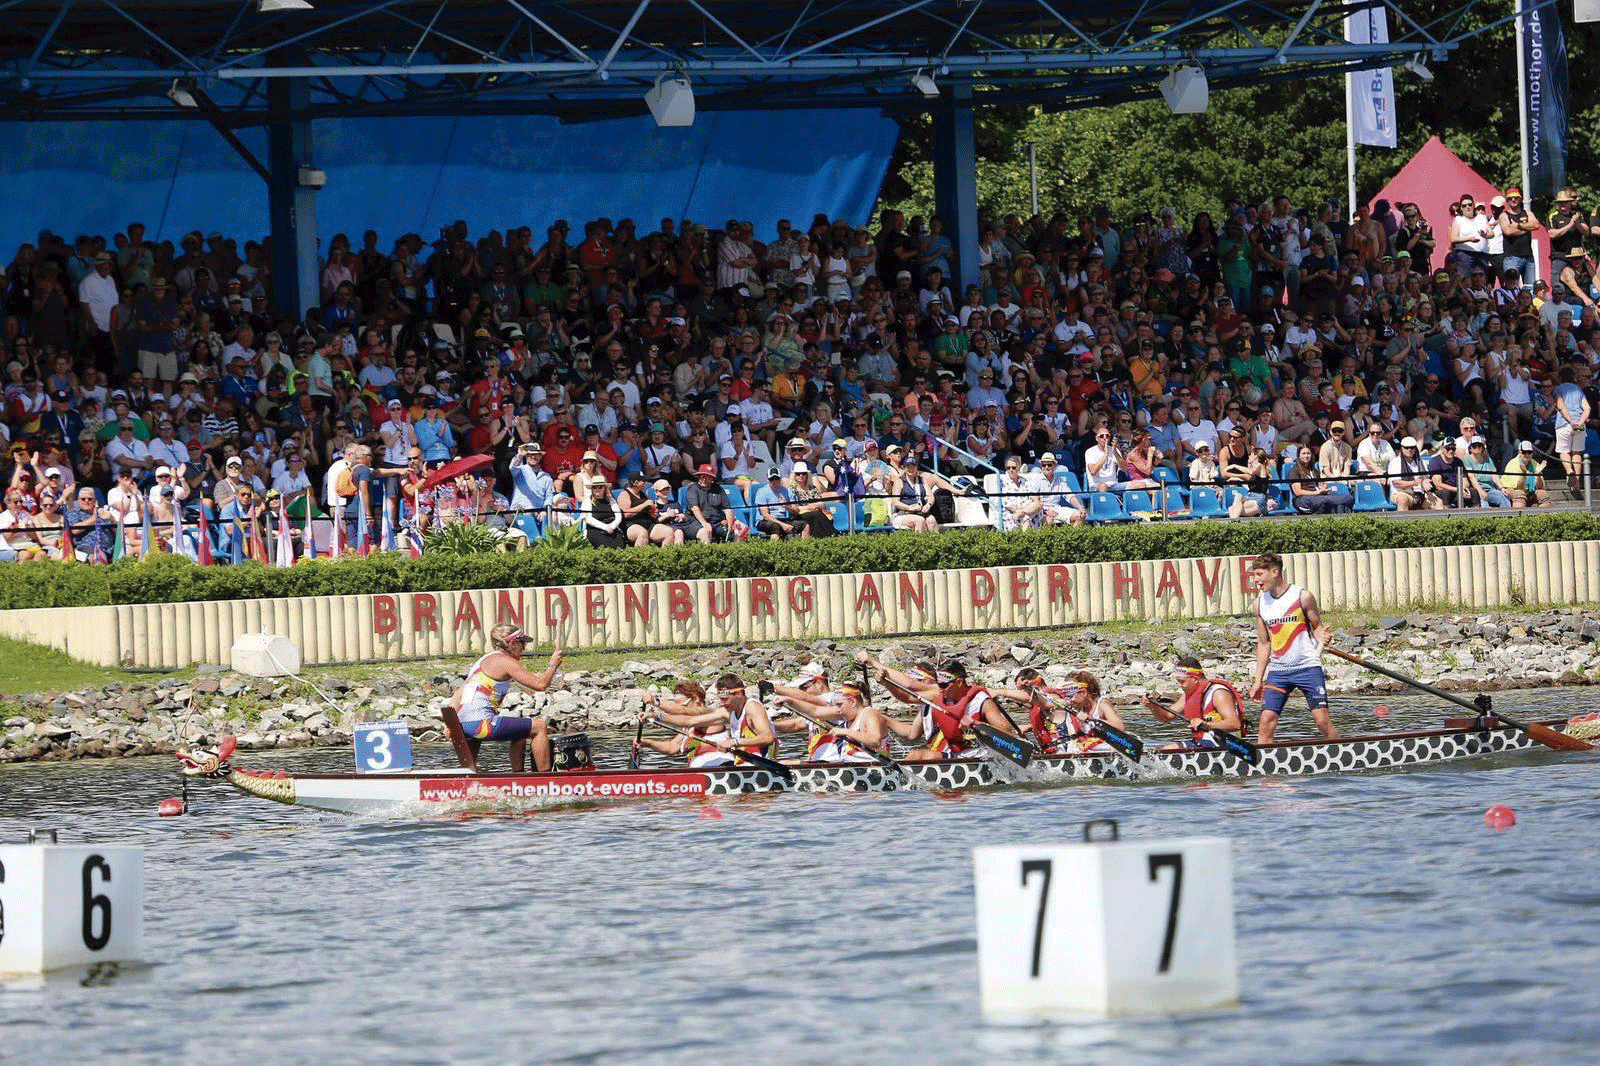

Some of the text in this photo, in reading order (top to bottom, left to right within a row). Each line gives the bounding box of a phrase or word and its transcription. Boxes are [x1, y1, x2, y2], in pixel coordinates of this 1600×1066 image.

[1528, 10, 1542, 166] www.mothor.de
[373, 576, 814, 635] BRANDENBURG
[856, 571, 924, 612] AN
[971, 564, 1073, 608] DER
[366, 730, 392, 770] 3
[82, 854, 112, 951] 6
[1021, 859, 1052, 978] 7
[1148, 853, 1183, 973] 7
